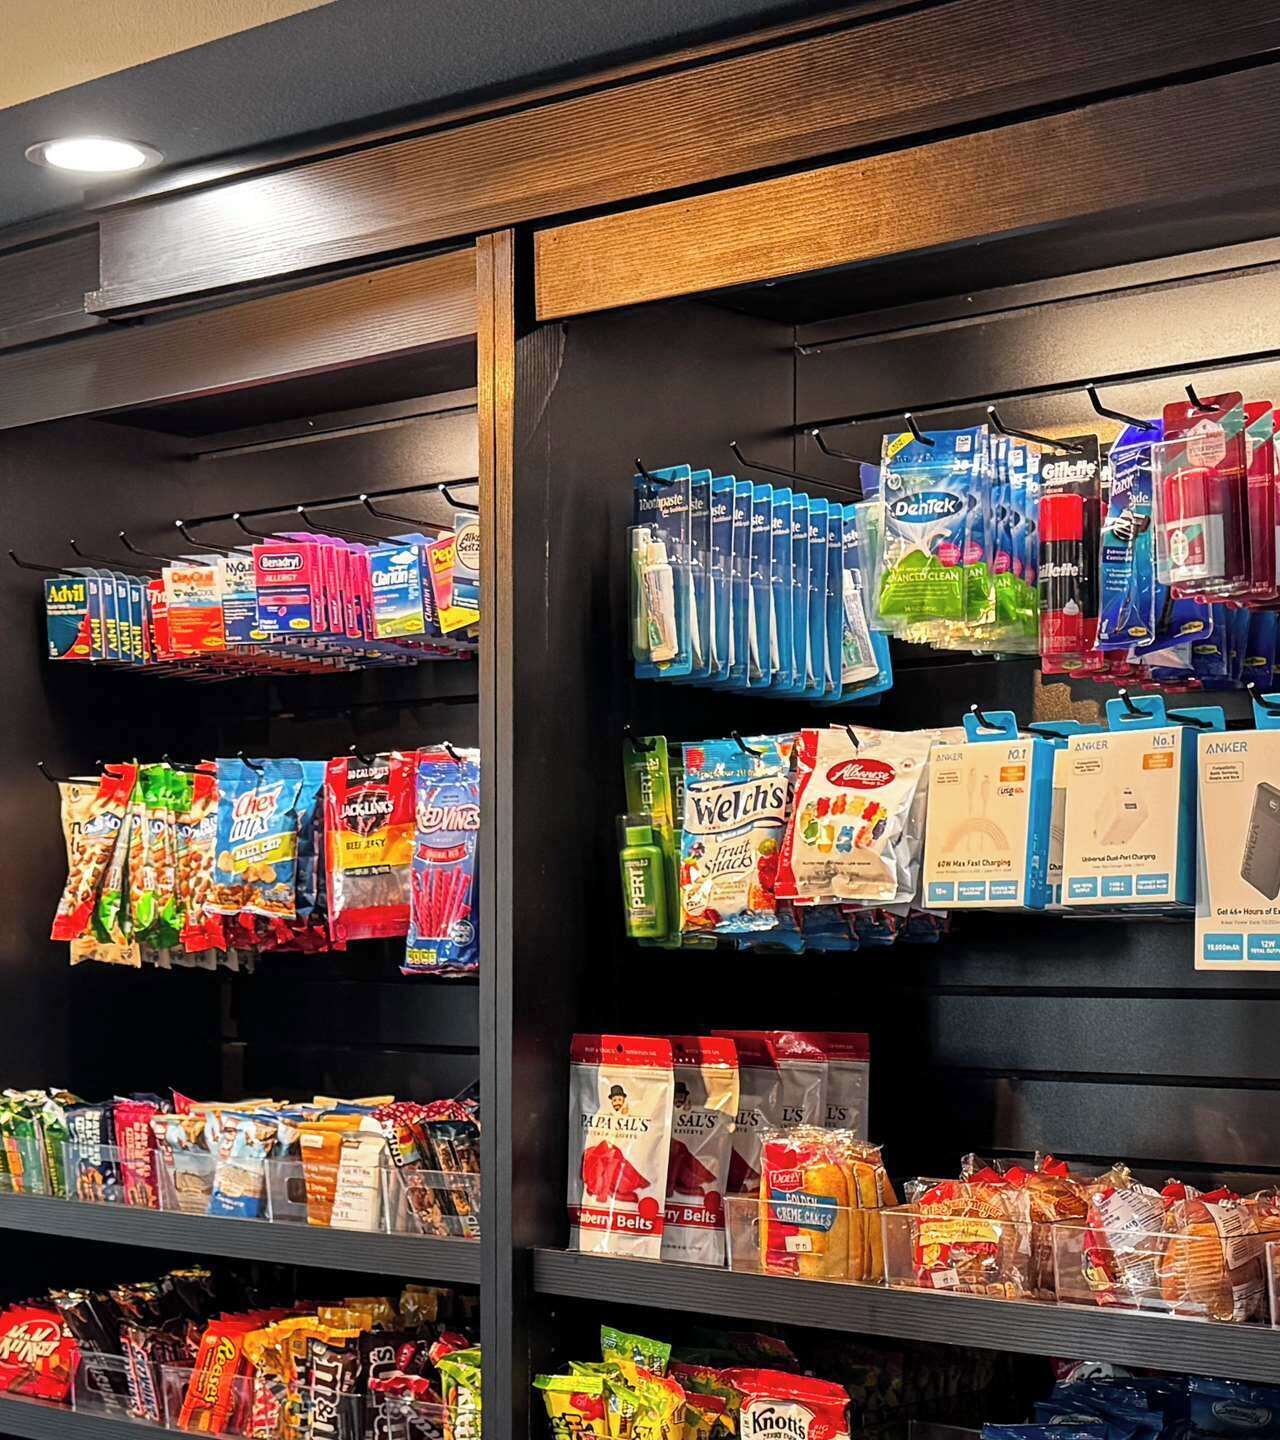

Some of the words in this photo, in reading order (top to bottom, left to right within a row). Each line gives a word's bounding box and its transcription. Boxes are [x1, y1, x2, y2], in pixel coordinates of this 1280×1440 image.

[1042, 460, 1097, 485] Gillette
[896, 495, 959, 517] DenTek
[262, 555, 301, 569] Benadryl
[49, 585, 86, 604] Advil
[1075, 740, 1110, 753] ANKER
[1153, 736, 1177, 748] No.1
[1207, 742, 1249, 756] ANKER
[936, 753, 965, 763] ANKER
[235, 788, 278, 818] Chex
[690, 780, 788, 828] Welch's
[715, 839, 753, 865] Fruit
[703, 852, 755, 881] Snacks
[982, 859, 1013, 870] Charging
[631, 868, 648, 911] PERT
[1218, 908, 1229, 917] Get
[1244, 908, 1265, 917] Hours
[1265, 907, 1273, 916] of
[616, 1118, 652, 1134] SAL'S
[678, 1113, 719, 1130] SAL'S
[684, 1208, 718, 1226] Belts
[777, 1208, 803, 1223] CREME
[618, 1218, 654, 1232] Belts
[751, 1406, 807, 1440] Knott's
